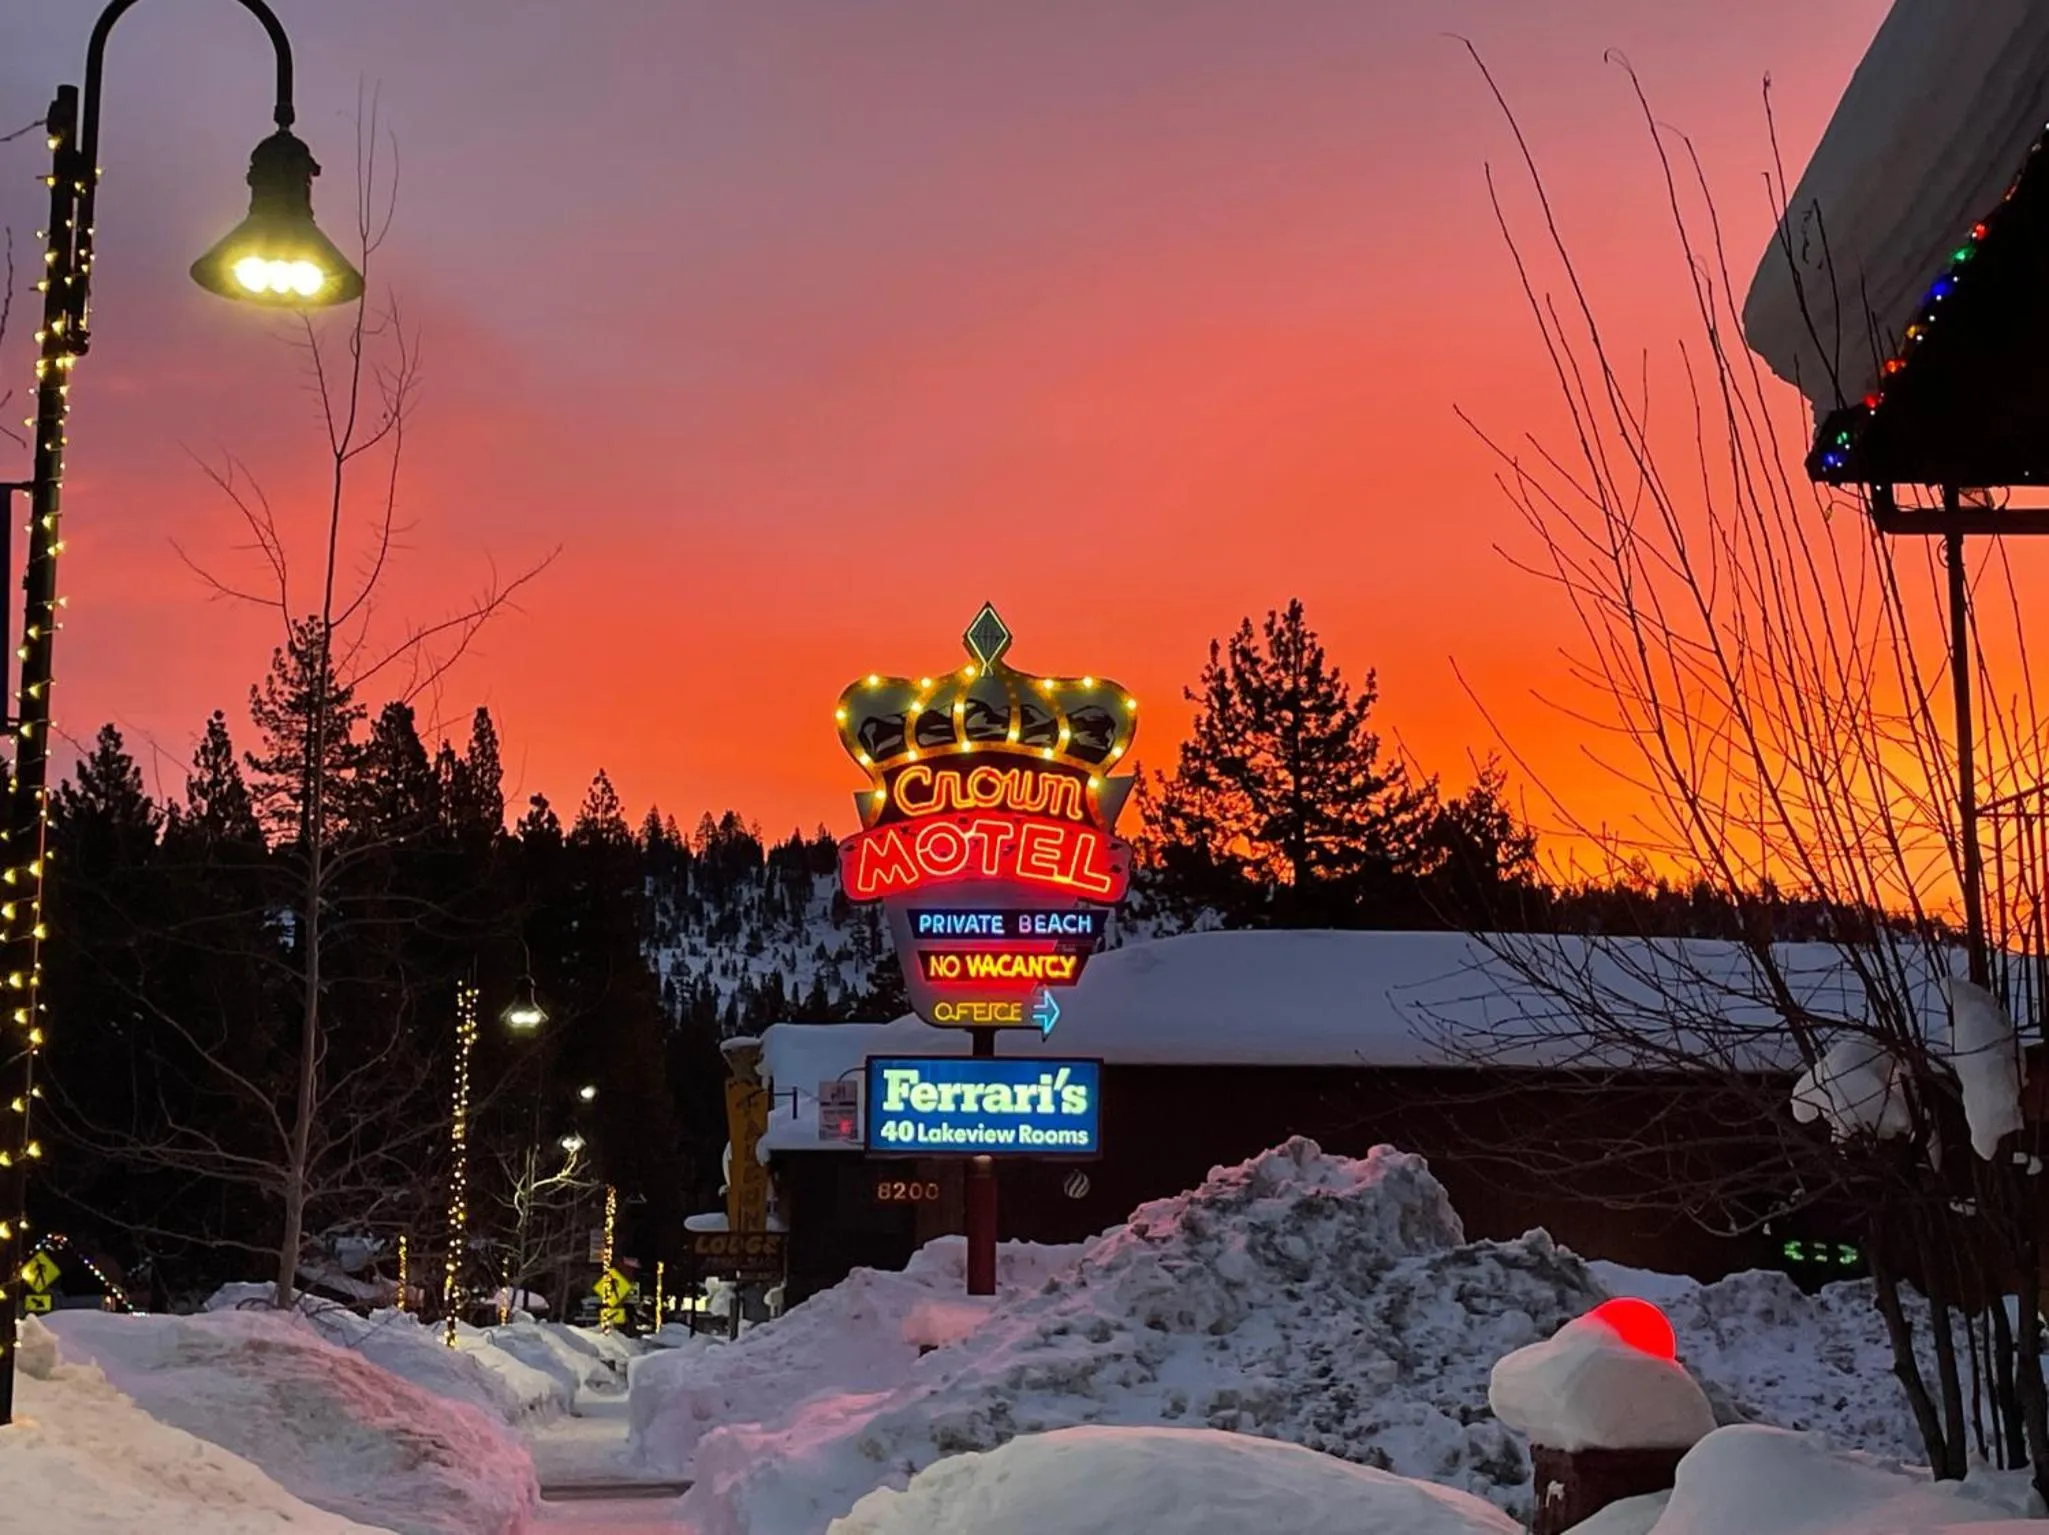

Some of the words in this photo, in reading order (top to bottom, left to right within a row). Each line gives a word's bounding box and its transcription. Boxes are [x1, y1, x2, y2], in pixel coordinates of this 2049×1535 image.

[894, 765, 1083, 820] Crown
[858, 819, 1111, 893] MOTEL
[919, 914, 1005, 933] PRIVATE
[1019, 914, 1092, 933] BEACH
[929, 955, 960, 977] NO
[966, 954, 1077, 978] VACANCY
[934, 1002, 1024, 1022] OFFICE
[882, 1067, 1088, 1114] Ferrari's
[880, 1120, 914, 1142] 40
[917, 1122, 1016, 1144] Lakeview
[1018, 1124, 1089, 1145] Rooms
[878, 1182, 940, 1200] 8200
